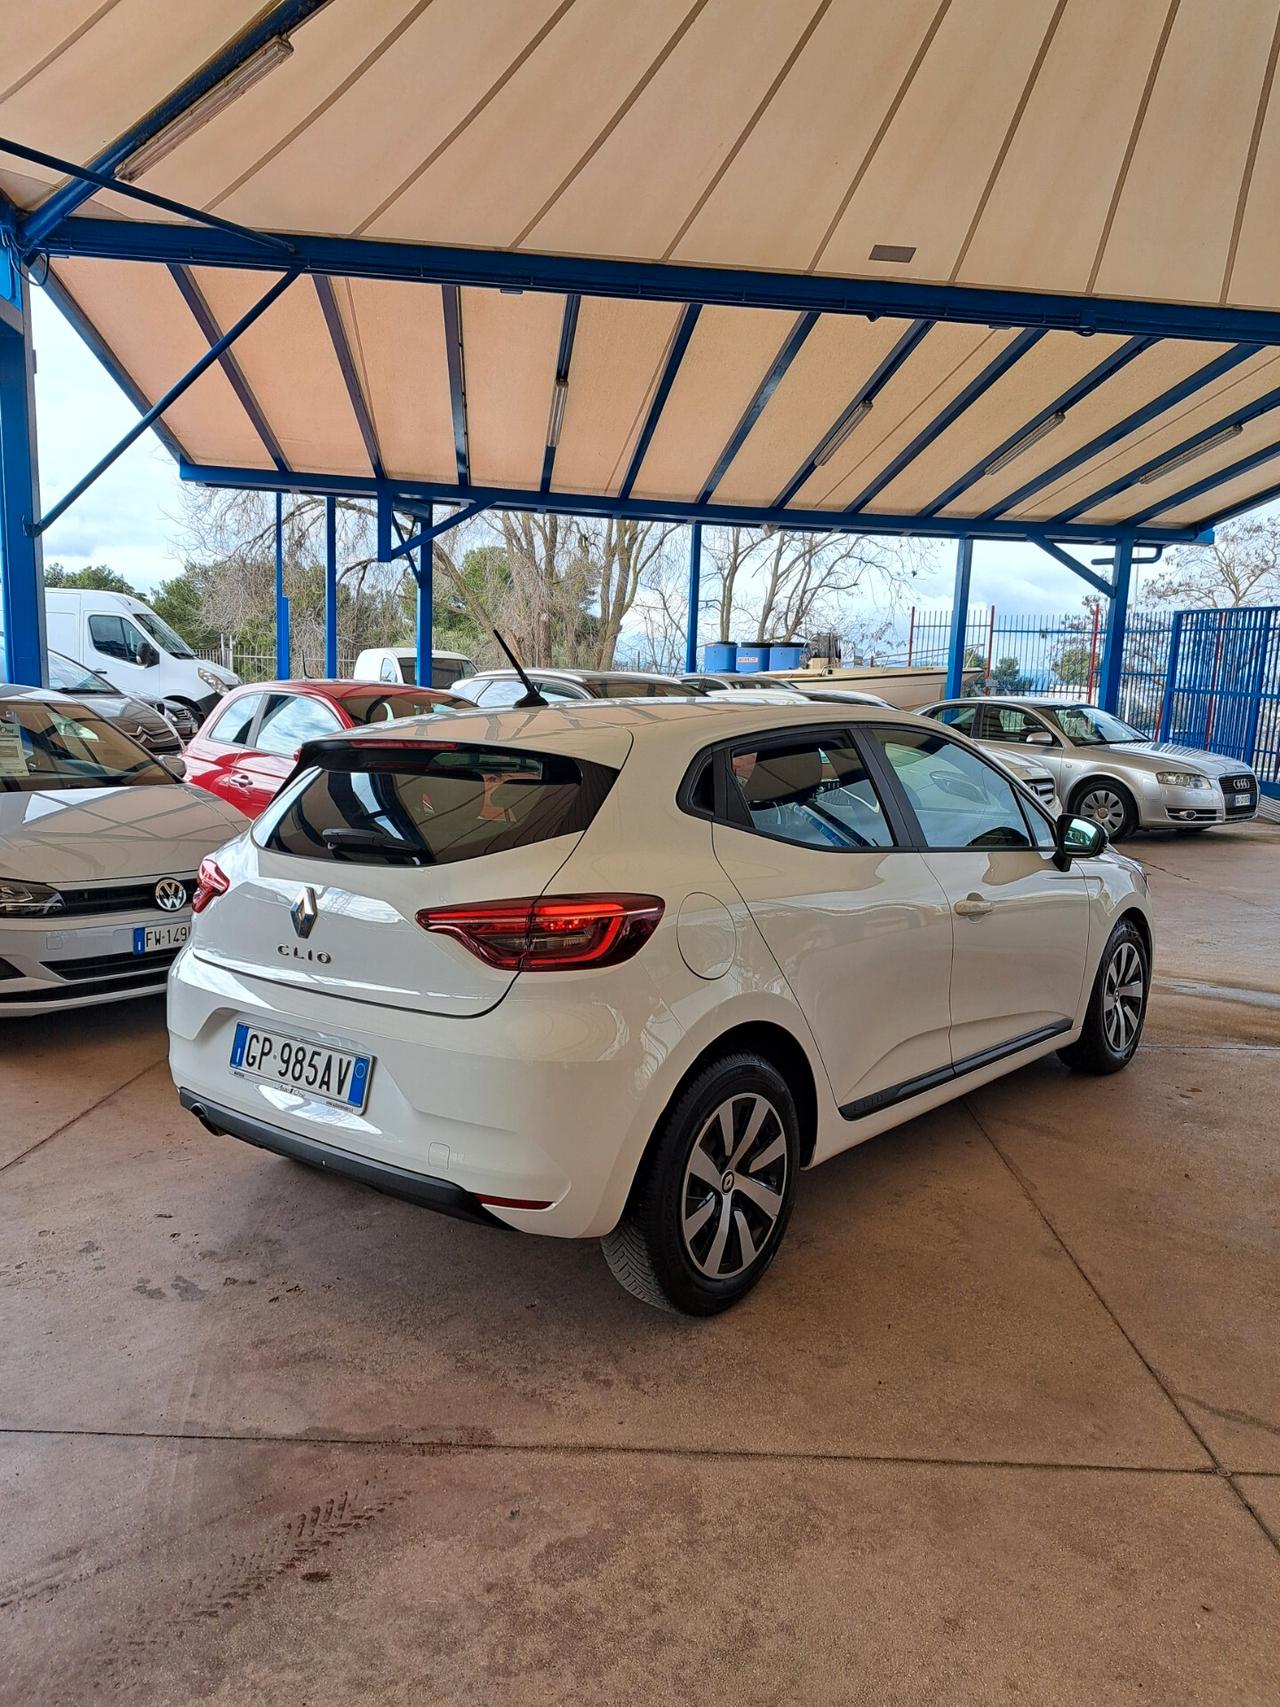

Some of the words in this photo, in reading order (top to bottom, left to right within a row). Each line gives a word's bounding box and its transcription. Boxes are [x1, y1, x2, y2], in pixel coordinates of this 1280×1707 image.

[146, 930, 162, 948] FW
[277, 943, 332, 964] CLIO
[245, 1033, 273, 1071] GP
[277, 1042, 352, 1096] 985AV
